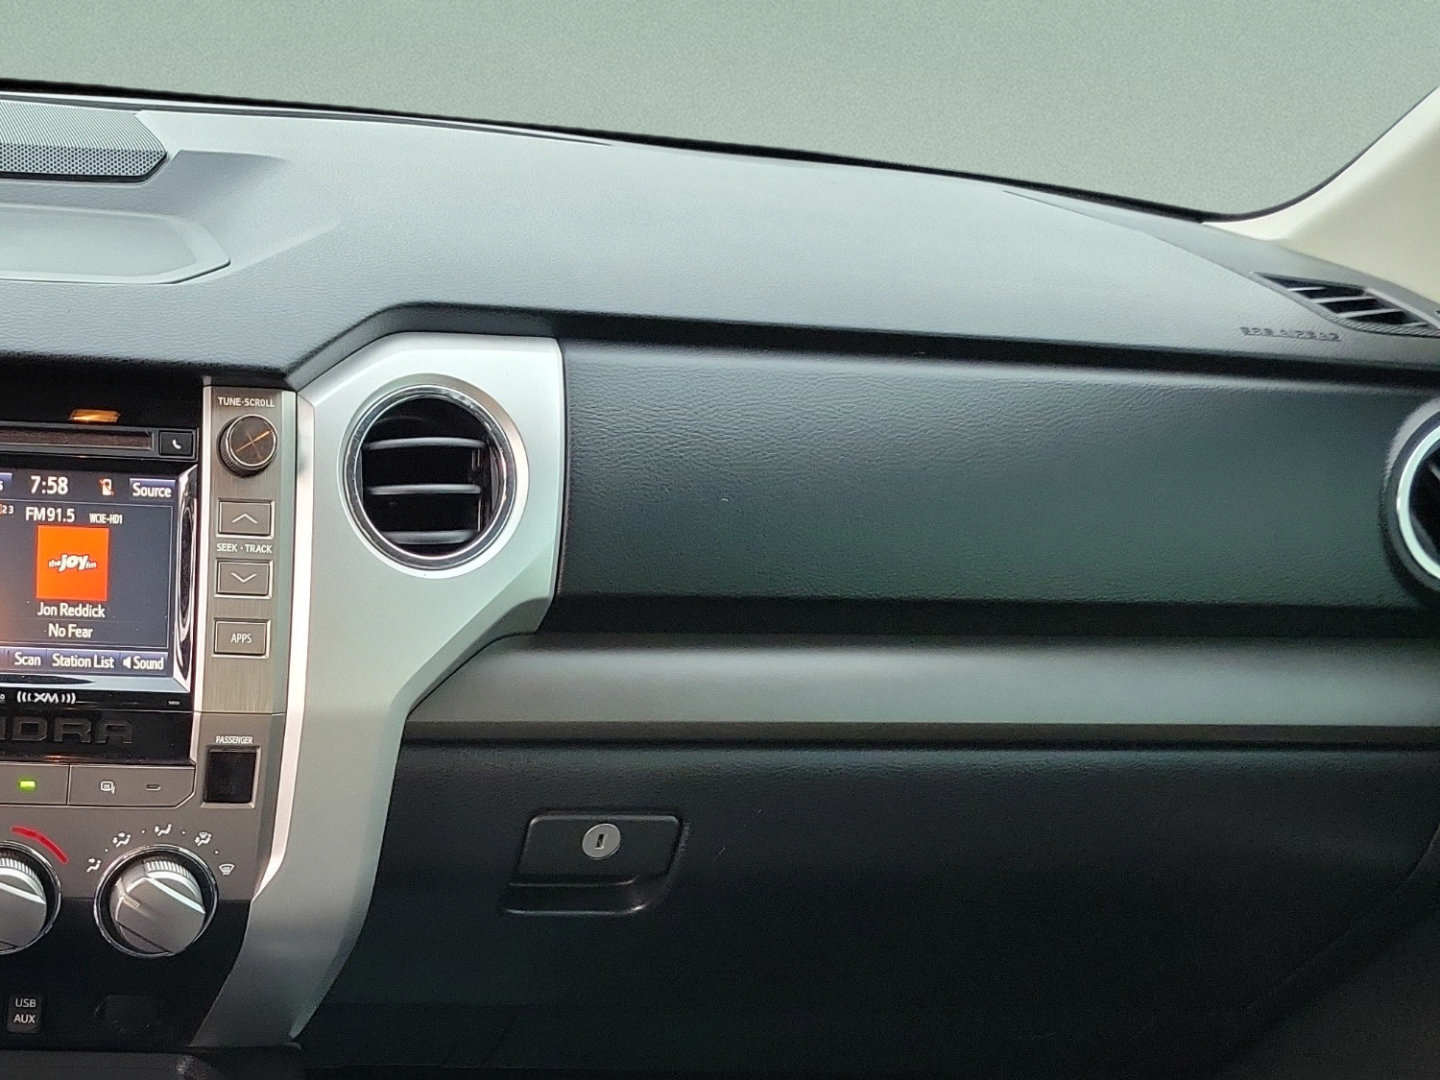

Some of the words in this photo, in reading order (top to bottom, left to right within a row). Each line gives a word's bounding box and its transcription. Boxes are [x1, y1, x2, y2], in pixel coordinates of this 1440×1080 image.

[30, 475, 69, 495] 7:58
[132, 482, 173, 499] Source
[216, 543, 238, 553] SEEK
[245, 543, 273, 554] TRACK
[37, 603, 58, 617] Jon
[59, 603, 106, 619] Reddick
[48, 624, 66, 638] No
[67, 625, 94, 639] Fear
[230, 633, 253, 645] APPS
[14, 652, 42, 667] Scan
[51, 653, 92, 669] Station
[93, 653, 115, 669] List
[133, 656, 165, 671] Sound
[215, 736, 254, 745] PASSENGER
[14, 998, 37, 1008] USB
[13, 1014, 36, 1024] AUX
